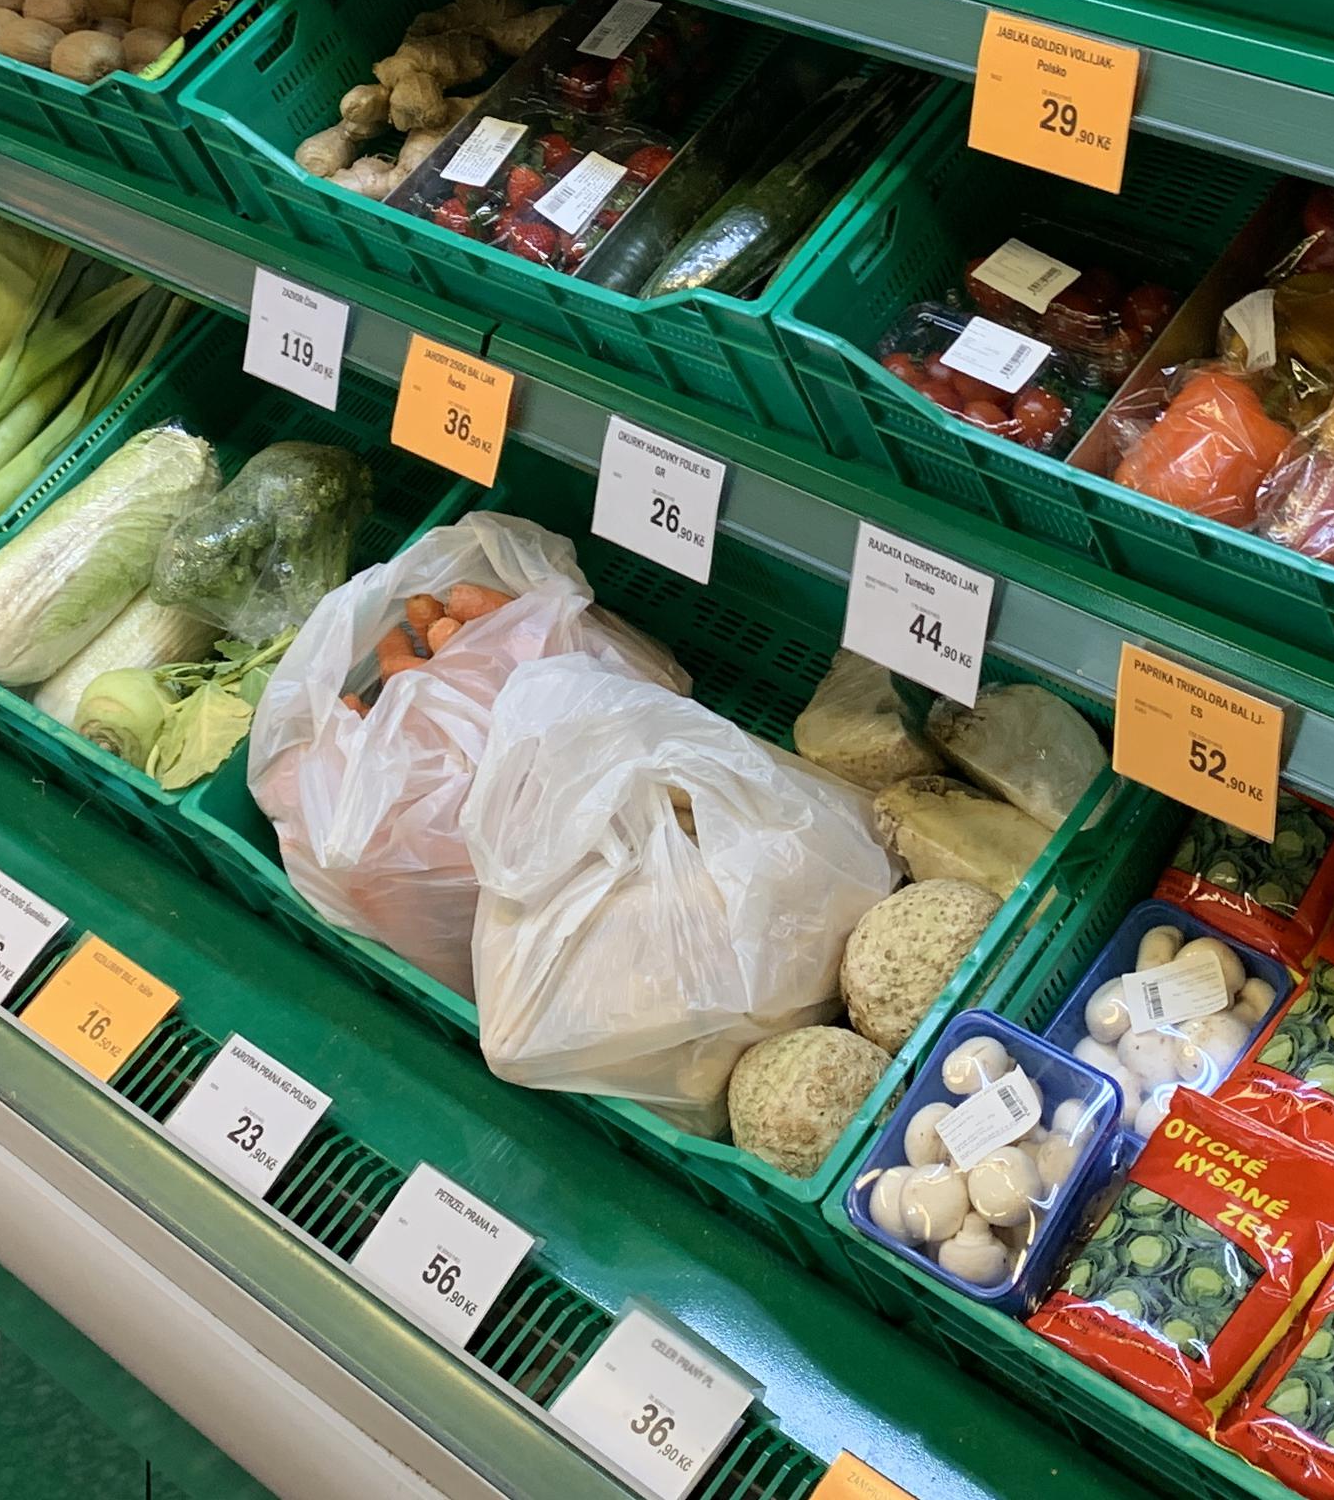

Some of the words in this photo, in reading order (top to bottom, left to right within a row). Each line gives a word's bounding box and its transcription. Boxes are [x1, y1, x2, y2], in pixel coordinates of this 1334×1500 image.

[996, 26, 1030, 46] JABLKA
[1031, 36, 1068, 57] GOLDEN
[1036, 58, 1067, 78] Polsko
[1096, 135, 1112, 151] Kč
[618, 430, 646, 451] OKURKY
[646, 441, 679, 466] HADOVKY
[679, 456, 700, 475] FOLIE
[700, 465, 712, 480] KS
[655, 465, 666, 479] GR
[693, 533, 706, 548] Kč
[867, 537, 903, 562] RAJCATA
[904, 572, 936, 596] Turecko
[958, 652, 973, 669] Kč
[1134, 659, 1175, 687] PAPRIKA
[1176, 678, 1229, 712] TRIKOLORA
[1230, 701, 1250, 719] BAL
[1190, 704, 1203, 720] ES
[1248, 784, 1264, 802] Kč
[230, 1045, 259, 1071] KAROTKA
[258, 1064, 282, 1085] PRANA
[279, 1079, 292, 1092] KG
[289, 1087, 317, 1111] POLSKO
[1163, 1116, 1269, 1179] OTICKÉ
[263, 1155, 278, 1171] Kč
[1174, 1150, 1291, 1220] KYSANÉ
[434, 1187, 465, 1215] PETRZEL
[463, 1208, 491, 1234] PRANA
[488, 1225, 500, 1239] PL
[1216, 1202, 1294, 1256] ZELÍ
[462, 1300, 479, 1317] Kč
[651, 1338, 679, 1362] CELER
[675, 1453, 694, 1472] Kč
